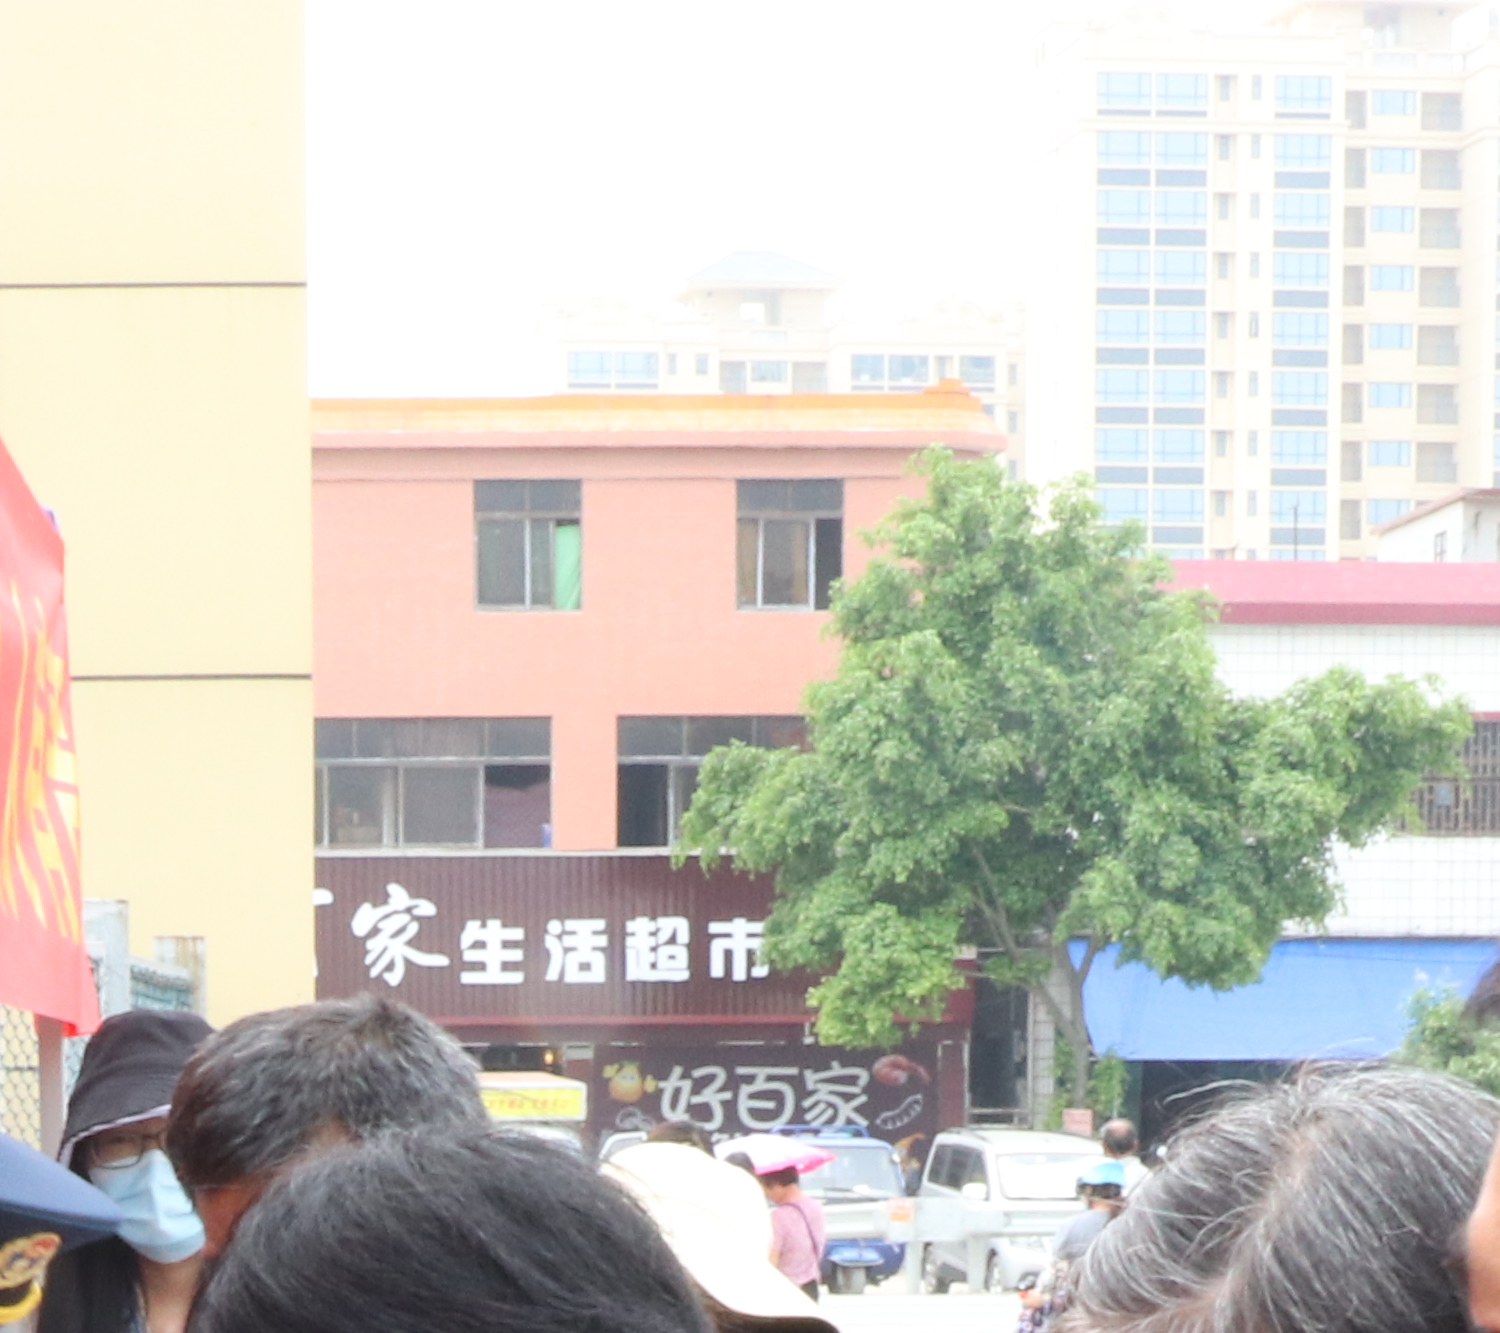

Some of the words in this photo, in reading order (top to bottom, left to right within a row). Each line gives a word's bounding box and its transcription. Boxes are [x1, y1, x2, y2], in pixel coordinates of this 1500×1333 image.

[313, 882, 771, 988] 家生活超市
[657, 1061, 871, 1132] 好百家
